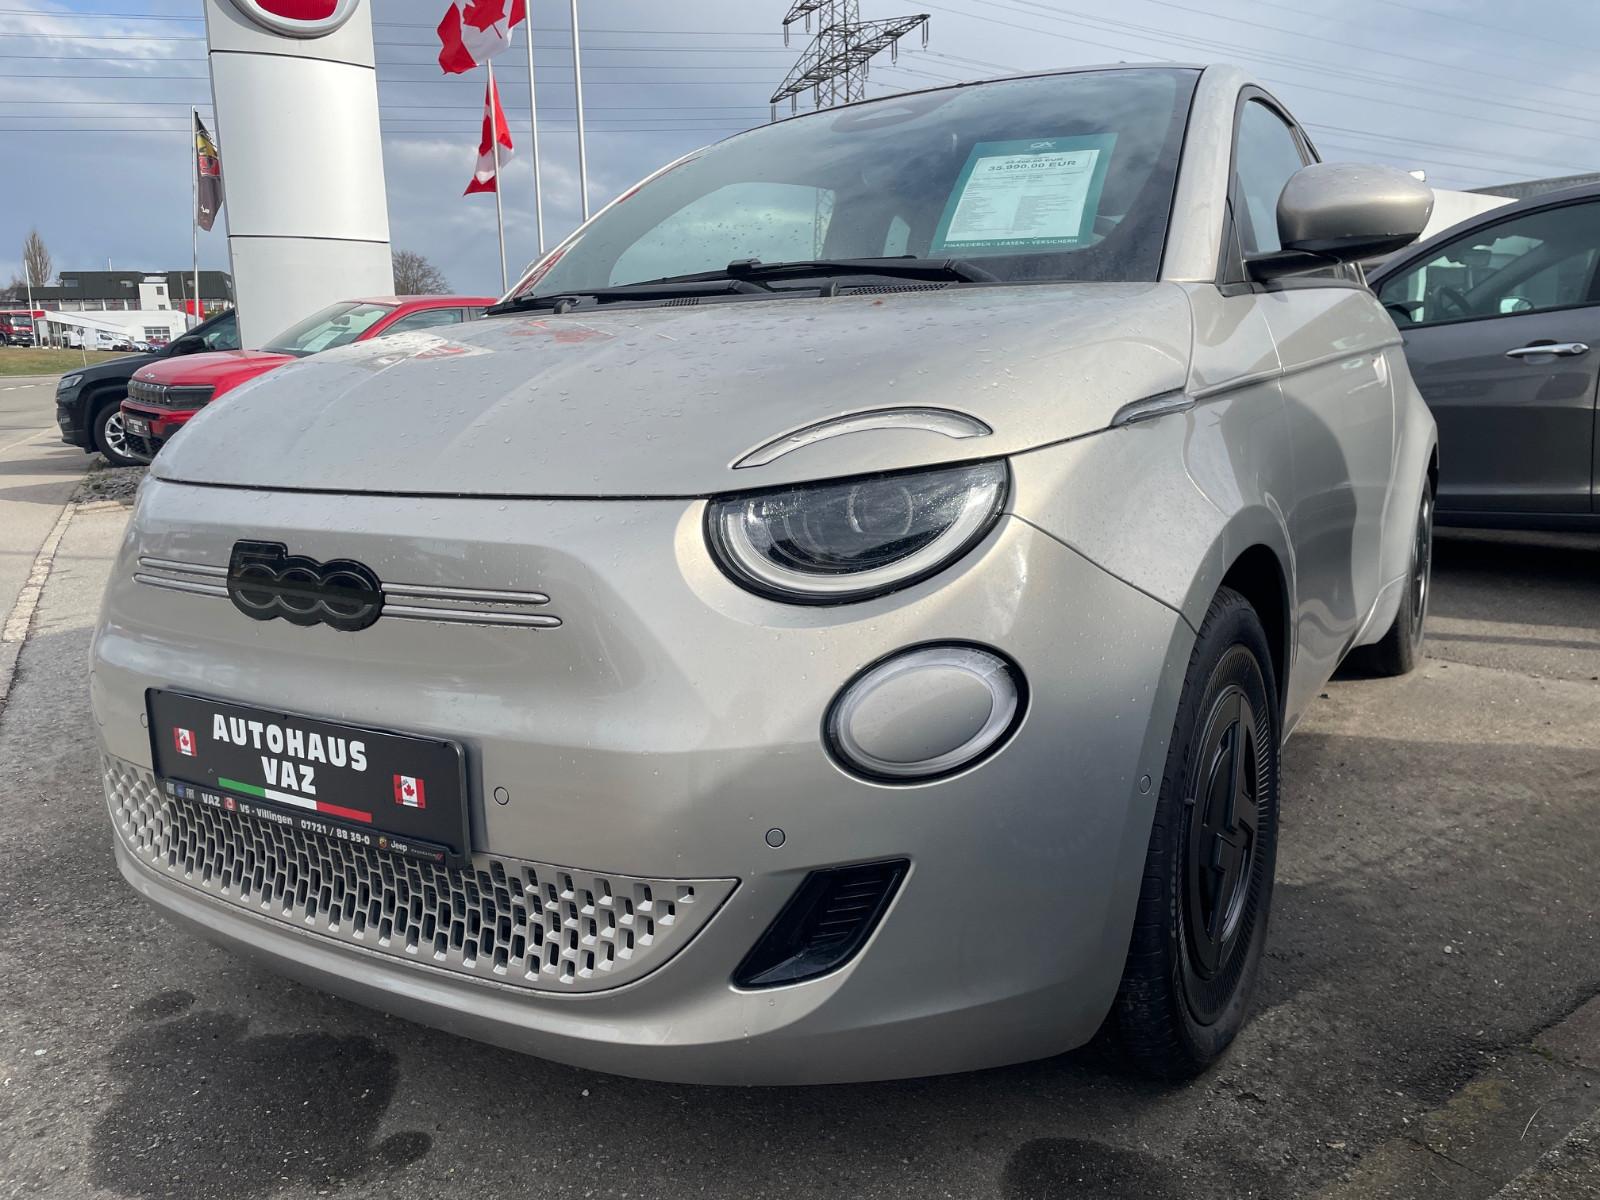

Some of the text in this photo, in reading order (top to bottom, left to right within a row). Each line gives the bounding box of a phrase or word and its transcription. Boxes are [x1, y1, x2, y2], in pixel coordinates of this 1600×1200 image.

[1049, 160, 1077, 168] EUR
[227, 539, 385, 631] 500
[213, 714, 368, 772] AUTOHAUS
[261, 756, 316, 795] VAZ
[201, 792, 221, 807] VAZ
[240, 803, 250, 814] VS
[256, 807, 293, 825] Villingen
[301, 820, 327, 834] 07721
[391, 840, 408, 854] Jeep
